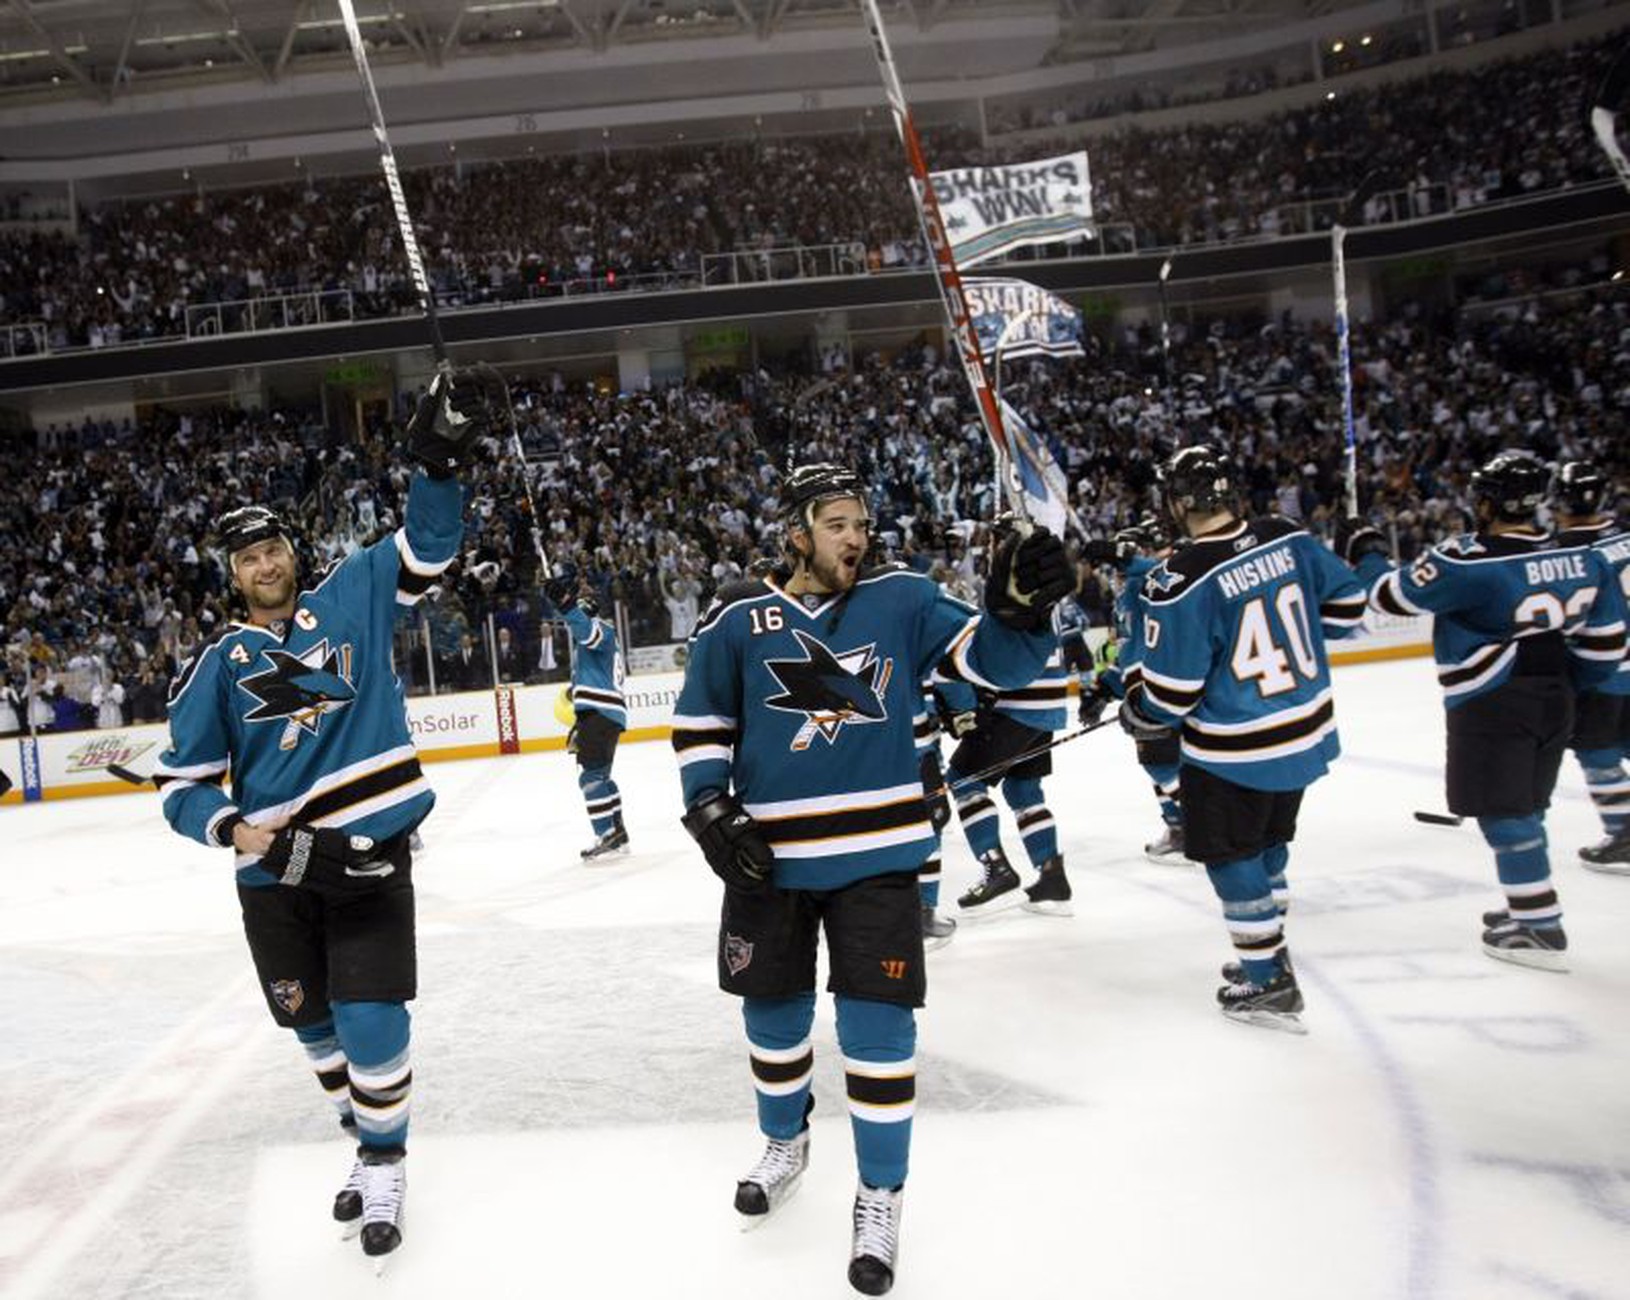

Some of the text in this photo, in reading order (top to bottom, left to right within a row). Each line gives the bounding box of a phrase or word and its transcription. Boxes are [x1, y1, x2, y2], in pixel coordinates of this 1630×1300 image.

[1217, 547, 1296, 599] HUSKINS
[1525, 555, 1587, 586] BOYLE
[295, 608, 318, 631] C
[749, 606, 784, 634] 16
[229, 643, 250, 664] 4
[1231, 583, 1318, 697] 40
